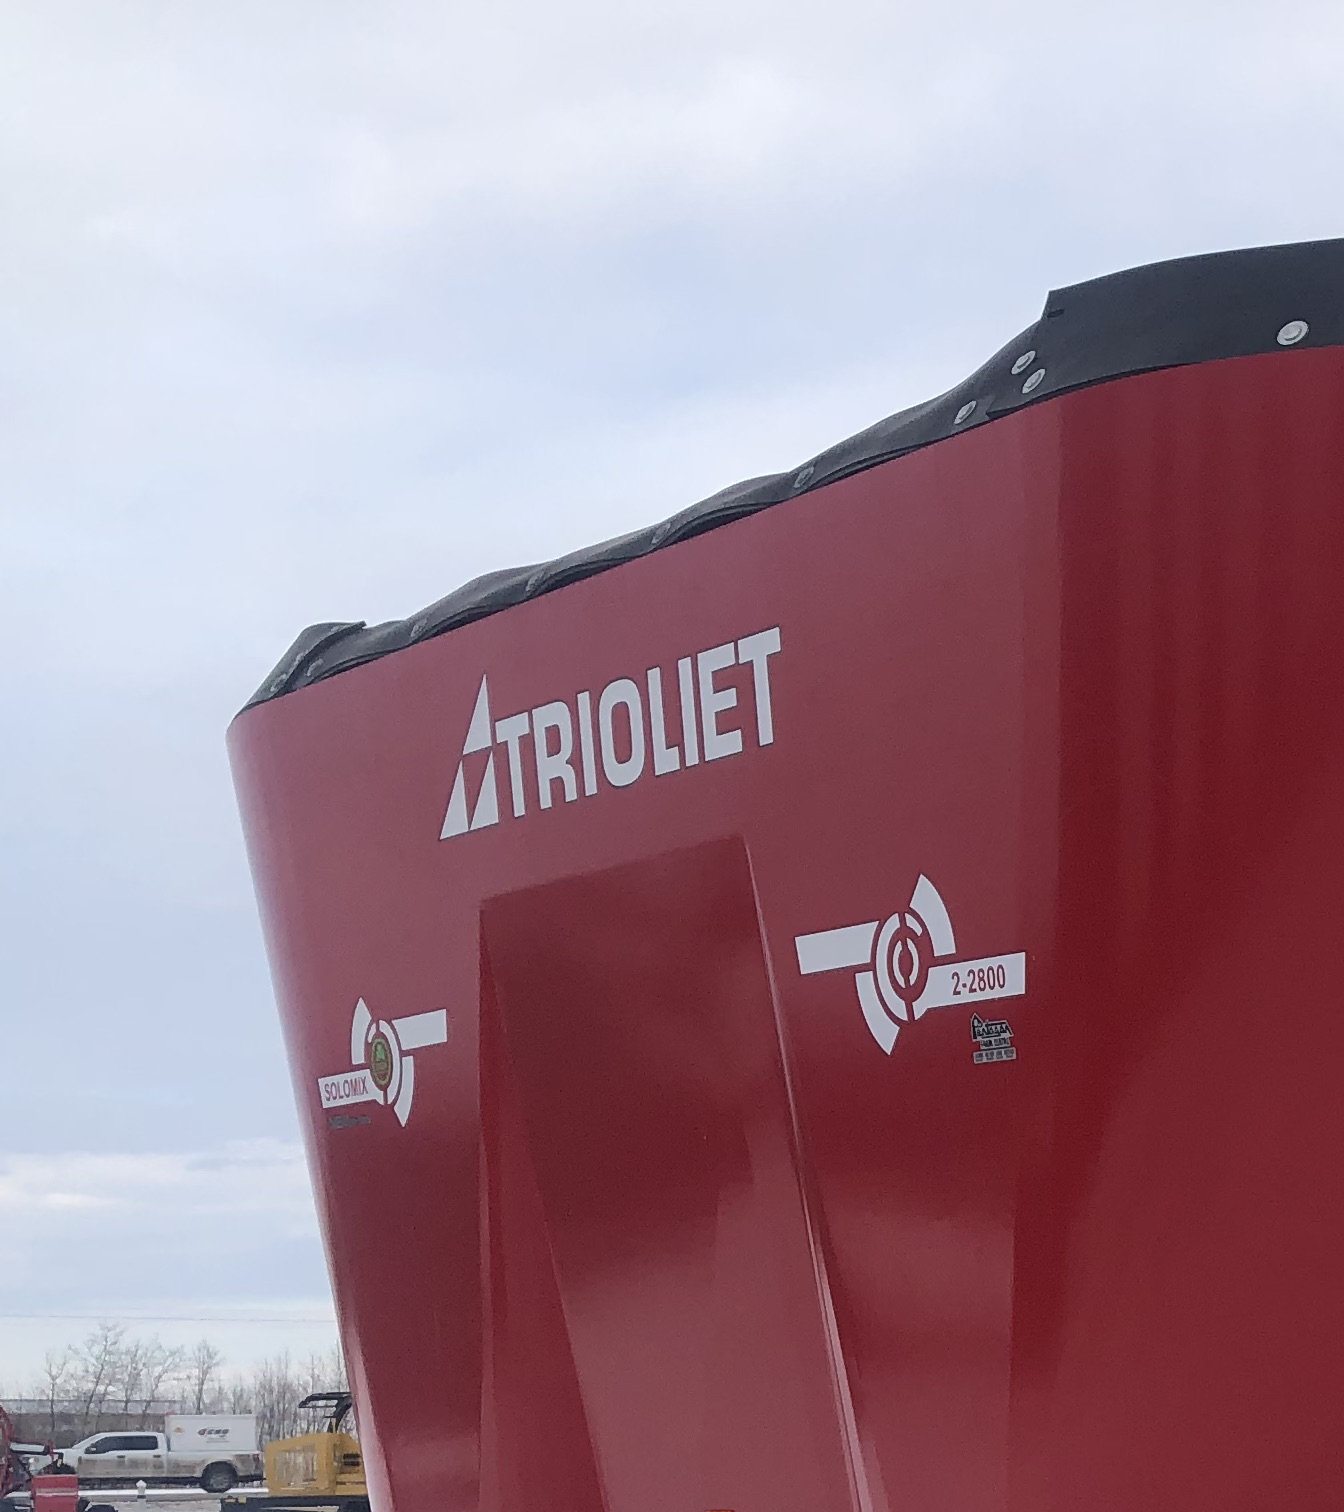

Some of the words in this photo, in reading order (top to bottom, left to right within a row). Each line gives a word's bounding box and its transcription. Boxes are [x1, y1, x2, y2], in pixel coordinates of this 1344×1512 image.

[495, 626, 782, 818] TRIOLIET
[951, 964, 1006, 996] 2-2800
[324, 1076, 369, 1102] SOLOMIX
